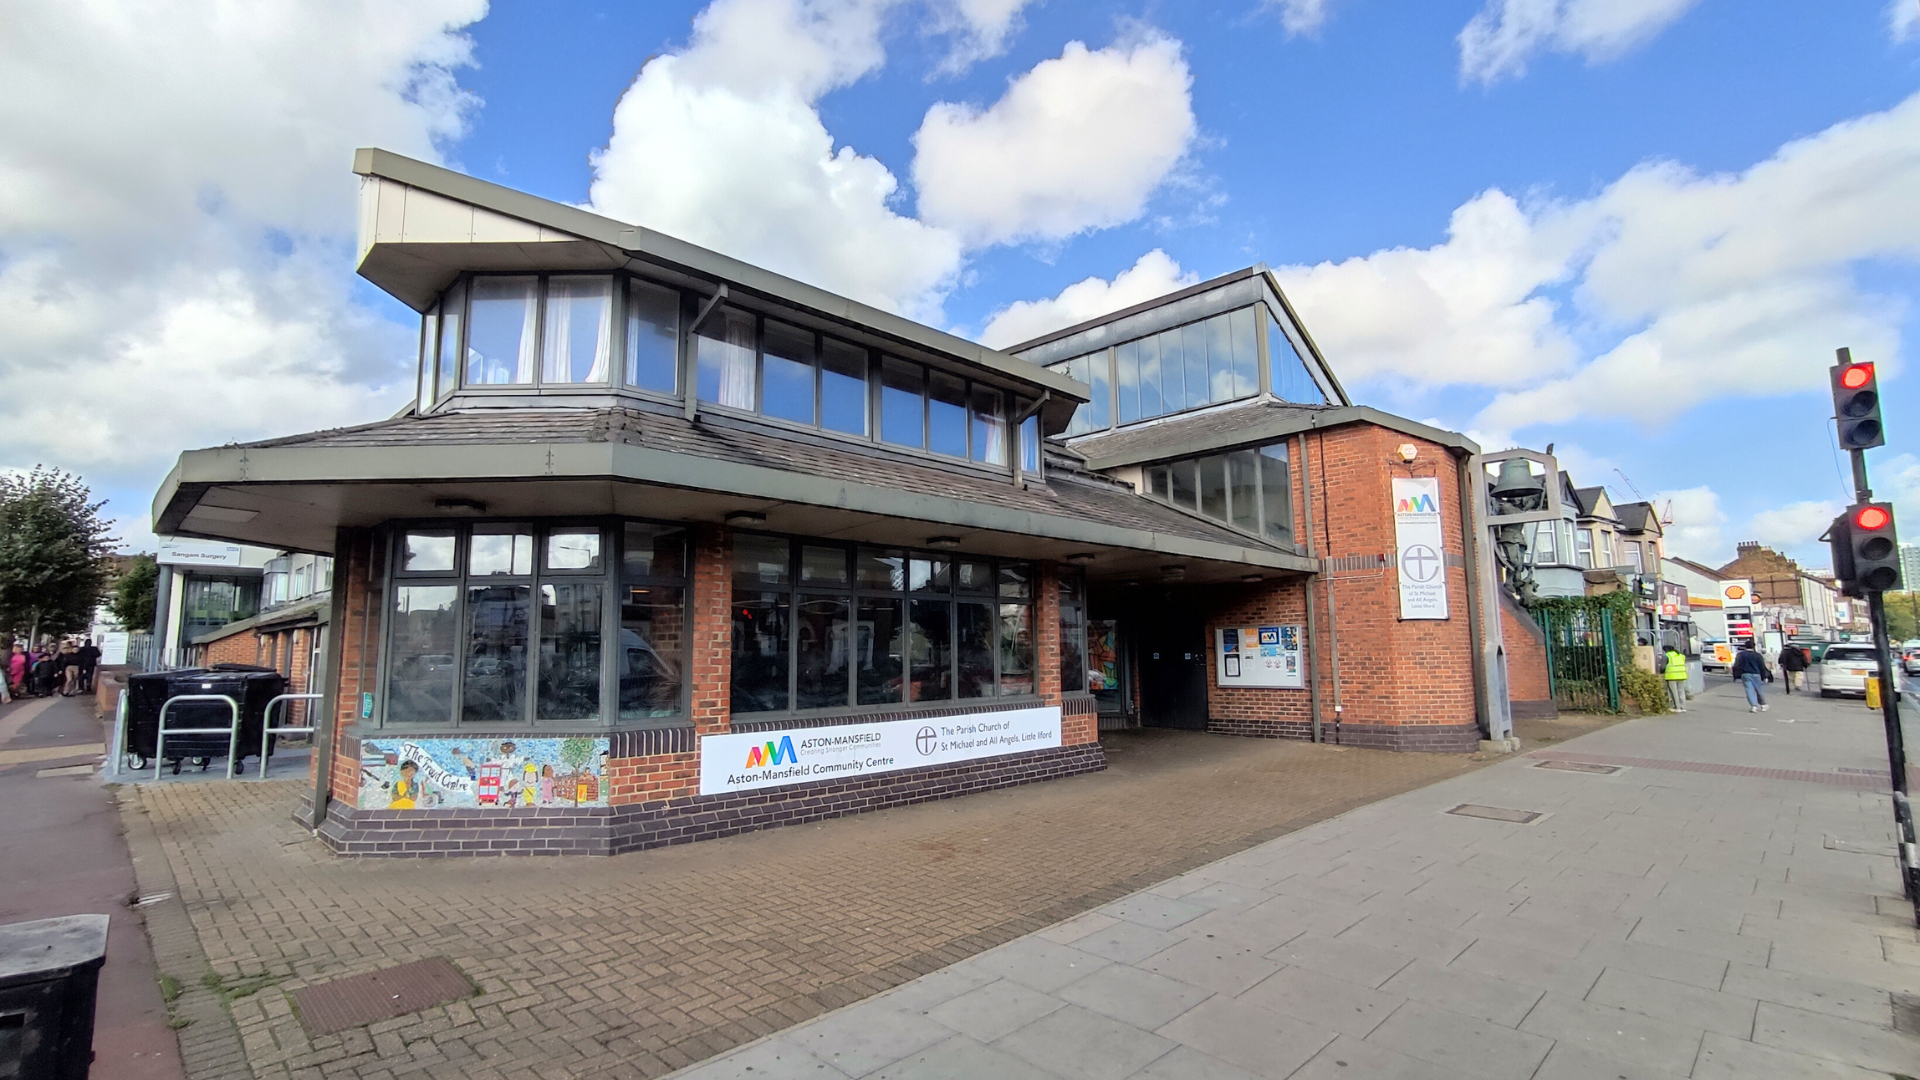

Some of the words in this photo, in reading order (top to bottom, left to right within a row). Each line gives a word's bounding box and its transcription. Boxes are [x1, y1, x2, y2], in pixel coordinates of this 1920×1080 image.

[941, 726, 955, 736] The
[956, 724, 977, 735] Parish
[978, 722, 1002, 732] Church
[1003, 721, 1010, 730] of
[800, 746, 824, 756] Creating
[825, 744, 847, 754] Stronger
[849, 742, 881, 751] Communities
[801, 732, 881, 748] ASTON-MANSFIELD
[941, 742, 948, 751] St
[950, 738, 974, 750] Michael
[976, 737, 988, 747] and
[989, 736, 998, 745] All
[999, 734, 1021, 745] Angels,
[1021, 732, 1036, 741] Little
[1037, 730, 1052, 740] Ilford
[404, 743, 424, 763] The
[441, 774, 469, 791] Centre
[727, 765, 810, 785] Aston-Mansfield
[812, 759, 864, 775] Community
[865, 756, 894, 768] Centre
